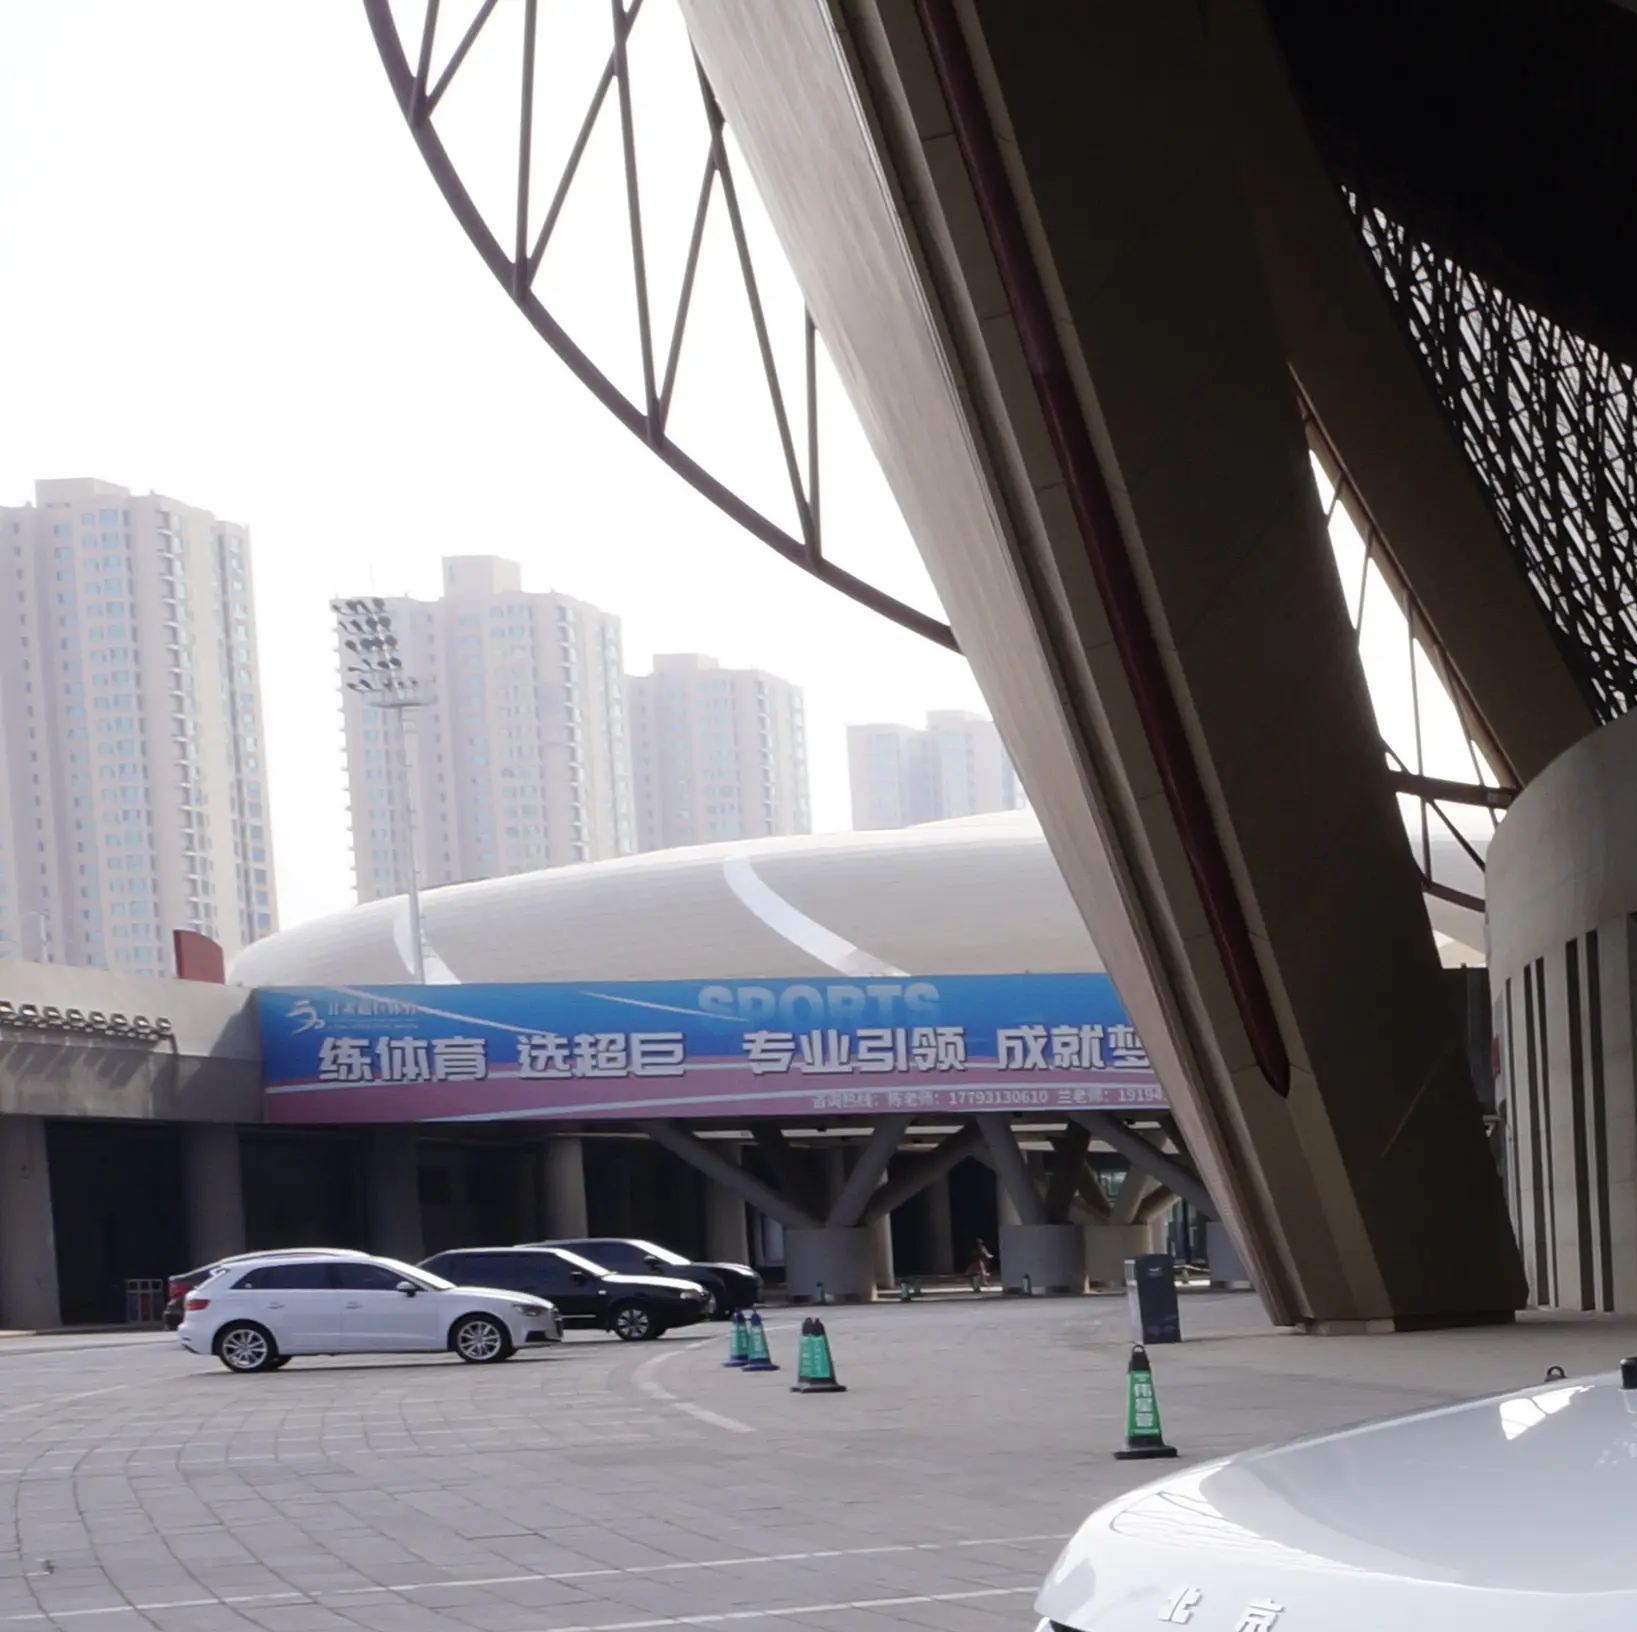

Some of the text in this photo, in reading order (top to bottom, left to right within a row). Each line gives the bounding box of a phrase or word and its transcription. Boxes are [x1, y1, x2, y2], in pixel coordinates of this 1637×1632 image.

[697, 984, 940, 1028] SPORTS
[318, 1035, 488, 1081] 练体育
[517, 1032, 685, 1080] 选超巨
[743, 1027, 966, 1077] 专业引领
